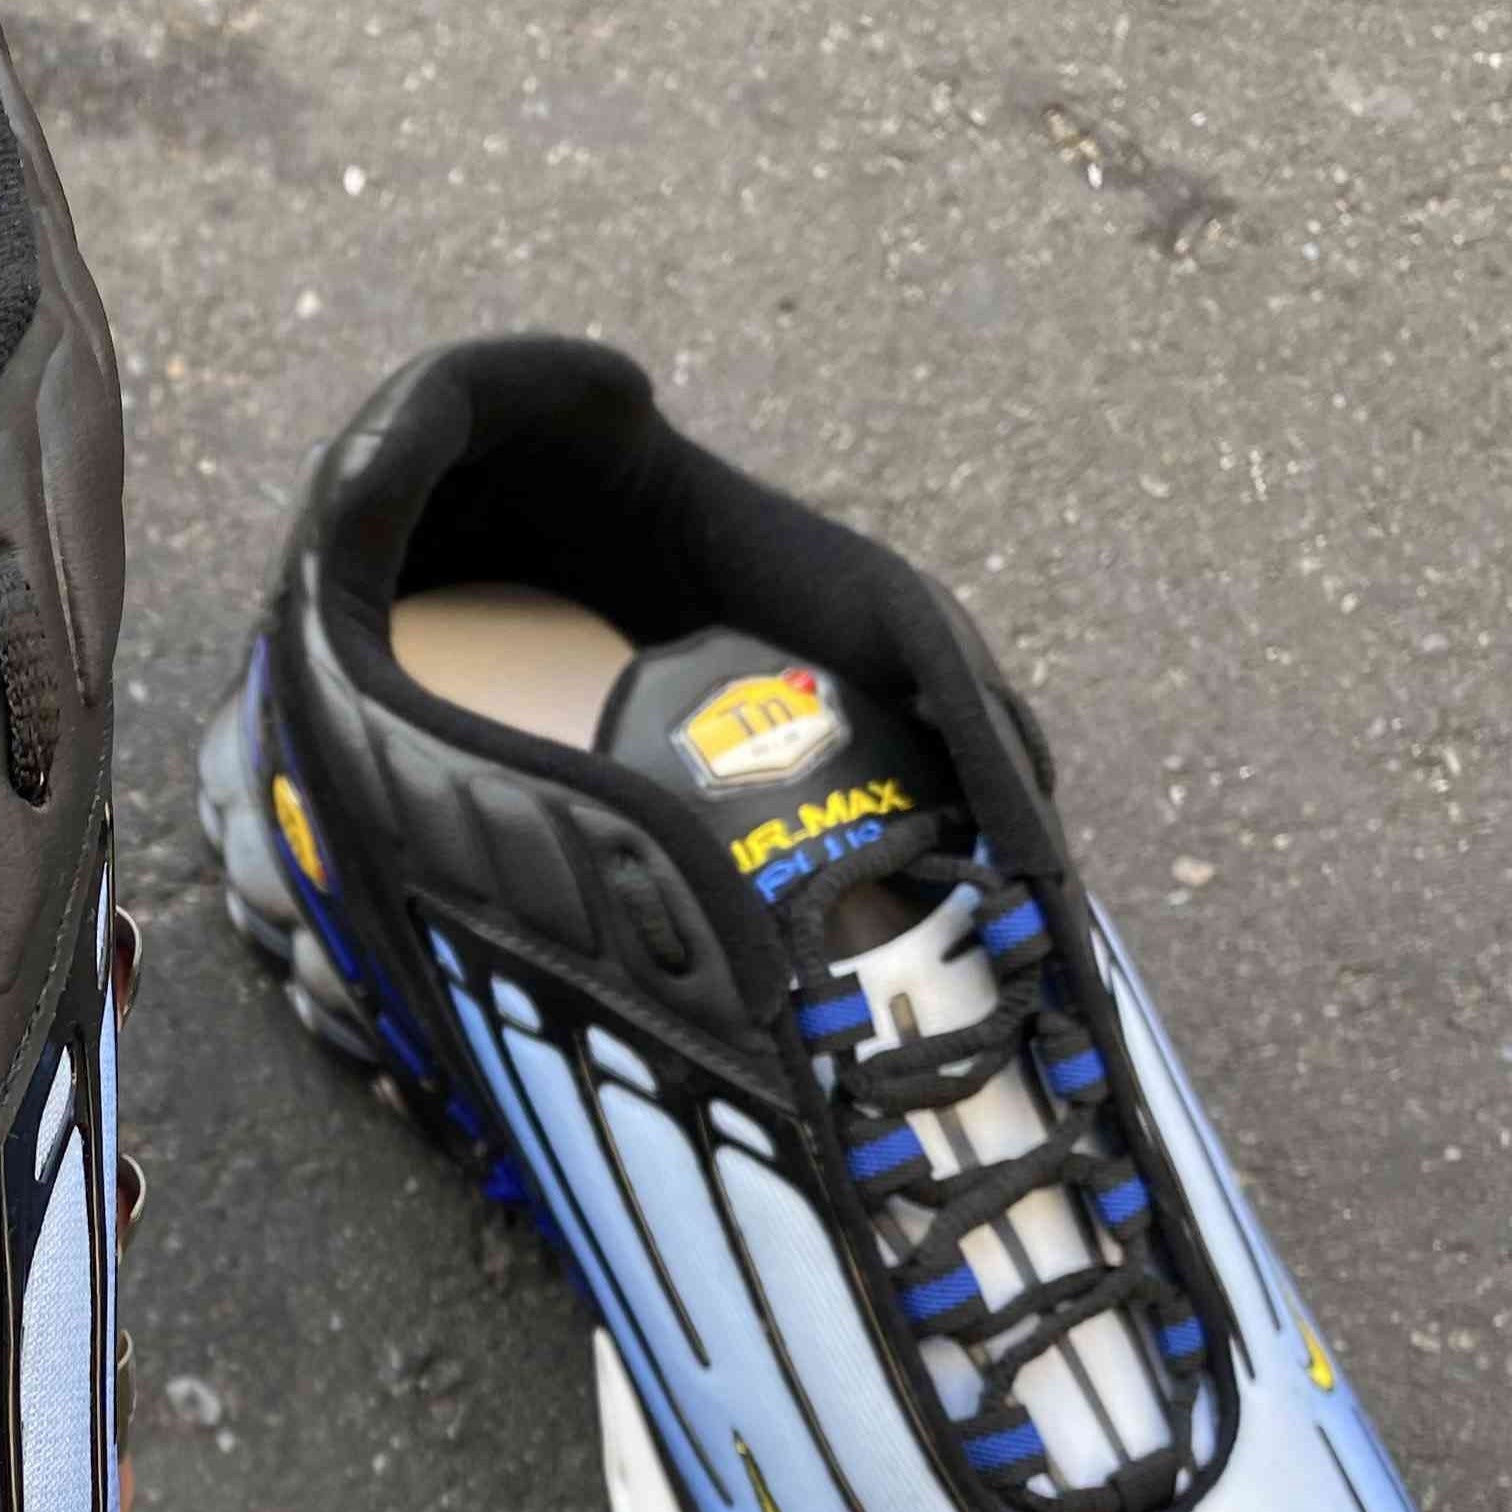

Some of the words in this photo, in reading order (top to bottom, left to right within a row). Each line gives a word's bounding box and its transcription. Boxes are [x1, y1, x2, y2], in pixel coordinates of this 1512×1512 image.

[723, 698, 792, 736] Tn
[730, 818, 795, 875] IR
[797, 778, 914, 837] MAX
